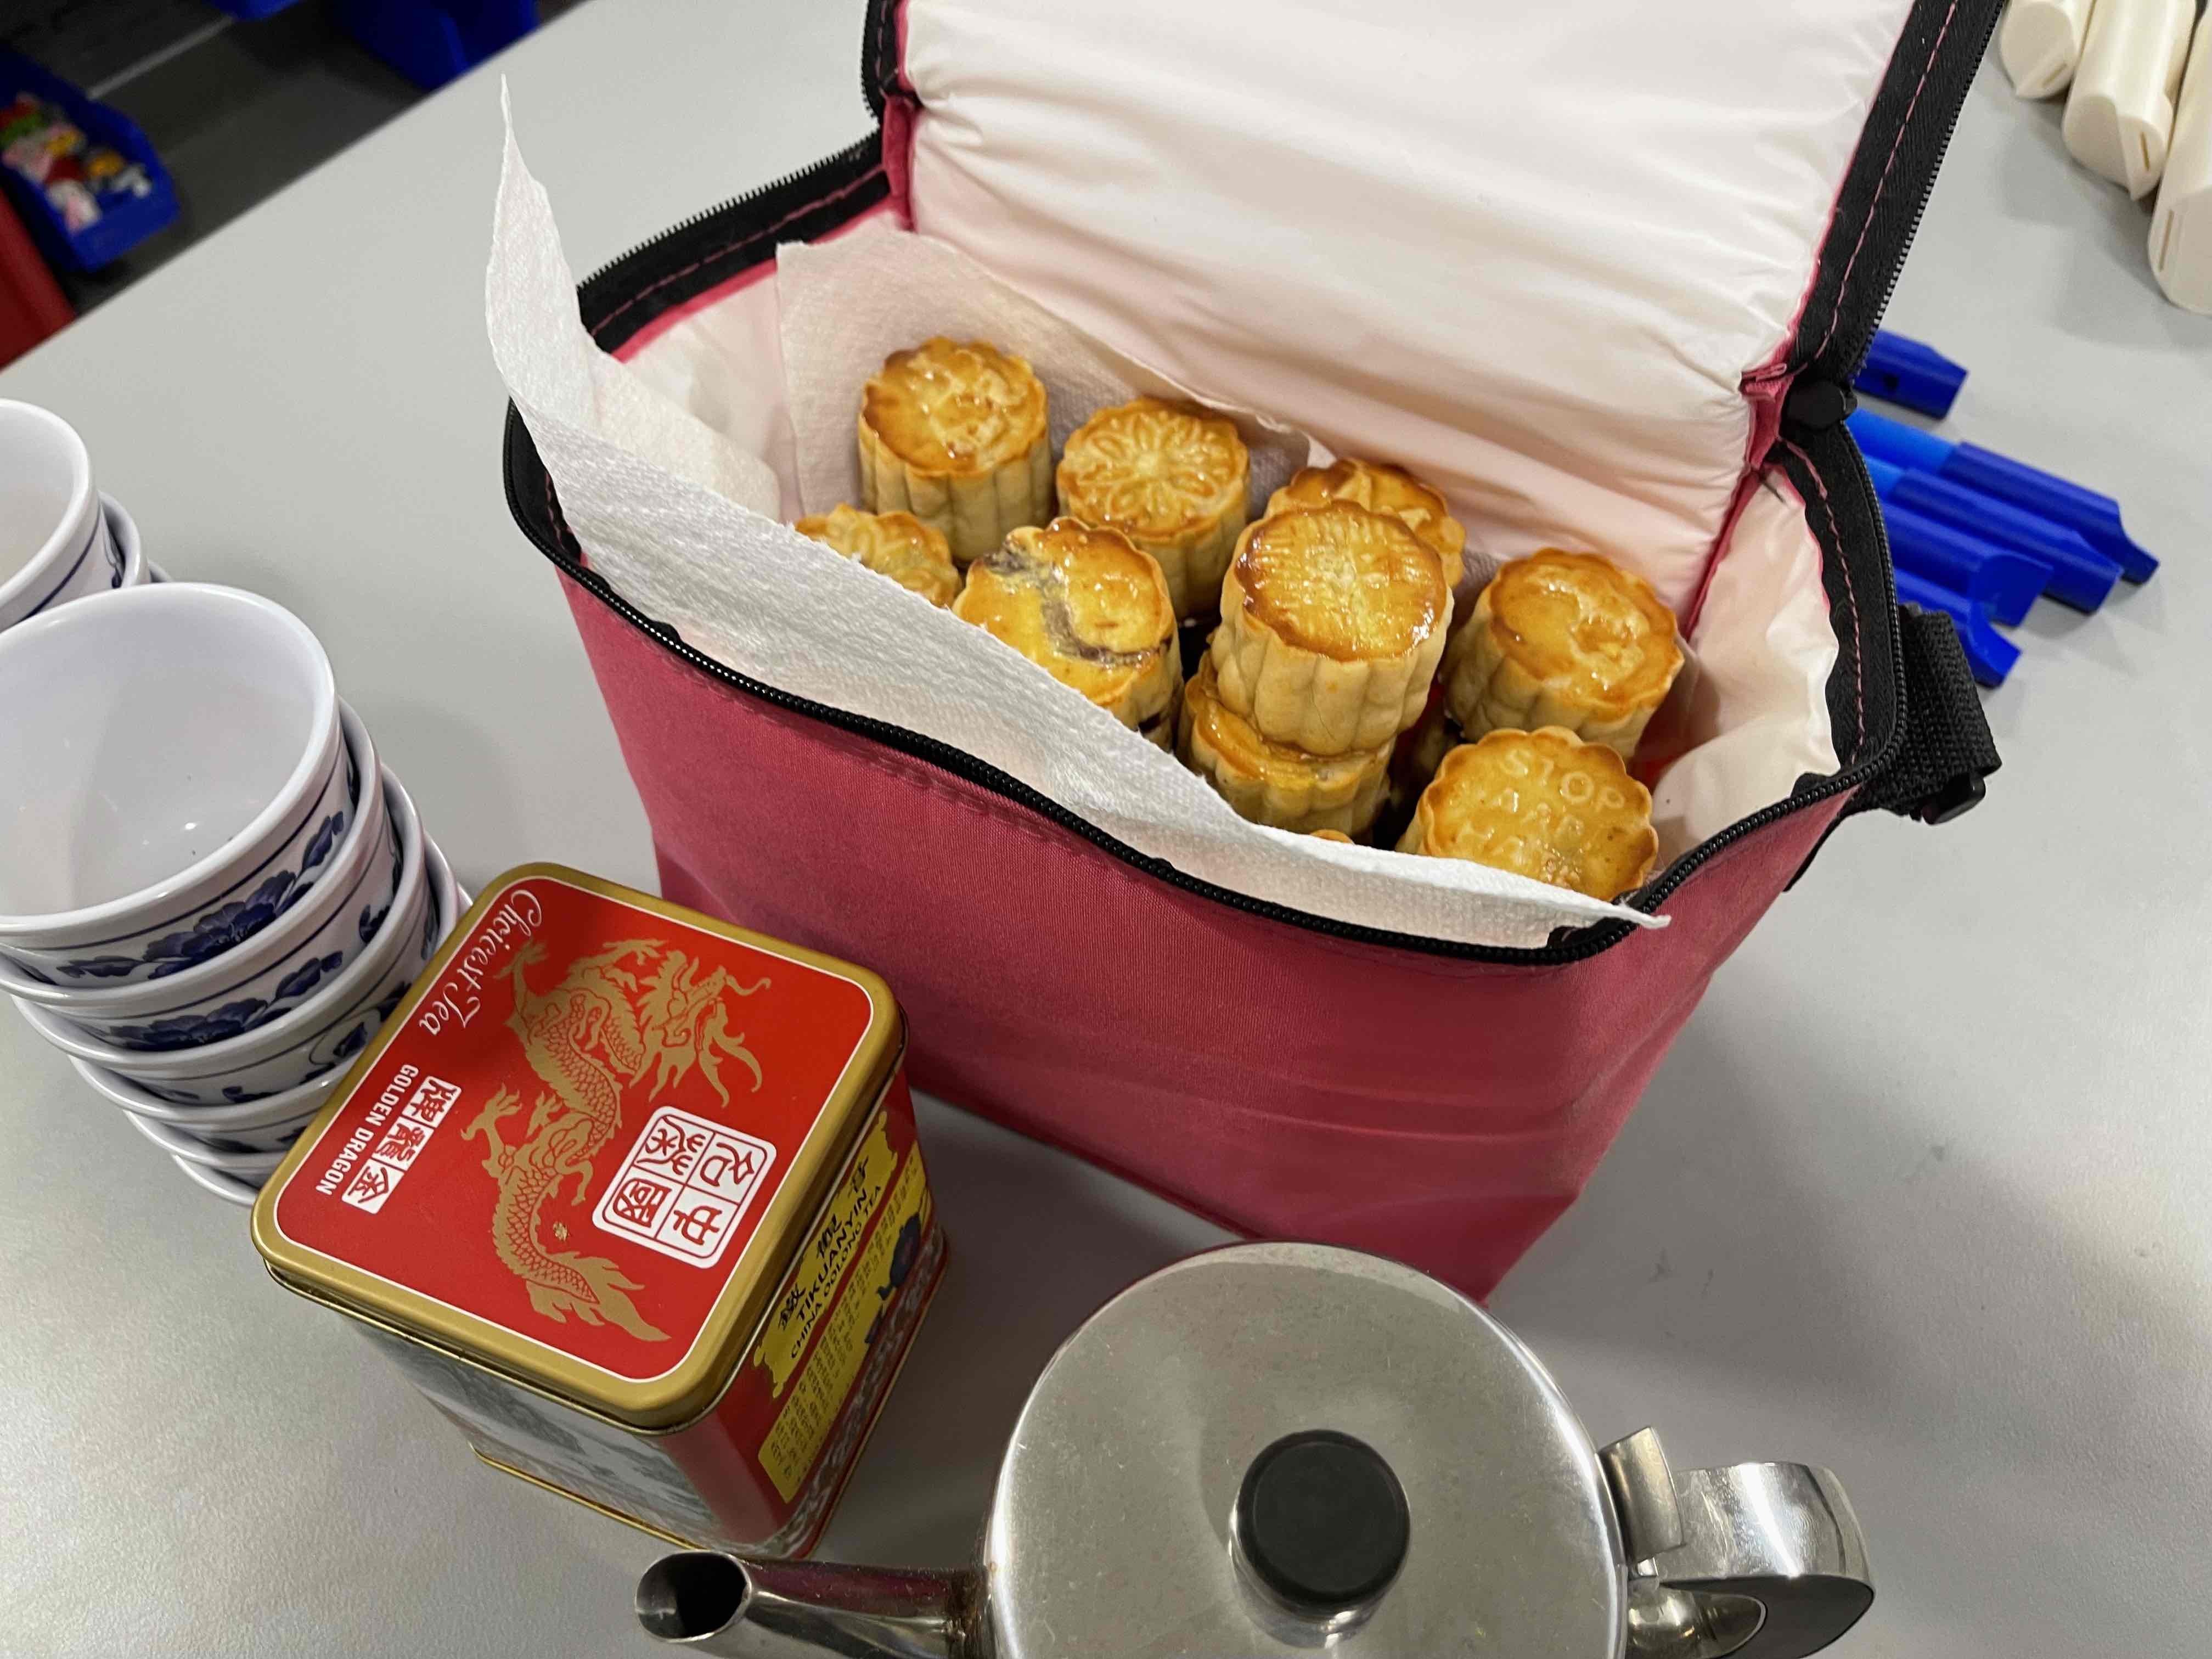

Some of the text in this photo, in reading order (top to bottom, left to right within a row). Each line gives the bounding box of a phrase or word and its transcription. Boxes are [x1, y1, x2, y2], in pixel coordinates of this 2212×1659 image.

[419, 889, 542, 1036] Choicest Tea
[316, 1064, 419, 1196] GOLDEN DRAGON
[791, 1302, 823, 1359] CHINA
[823, 1222, 862, 1297] OOLONG
[864, 1185, 881, 1216] TEA
[797, 1188, 868, 1322] TIKUANYIN
